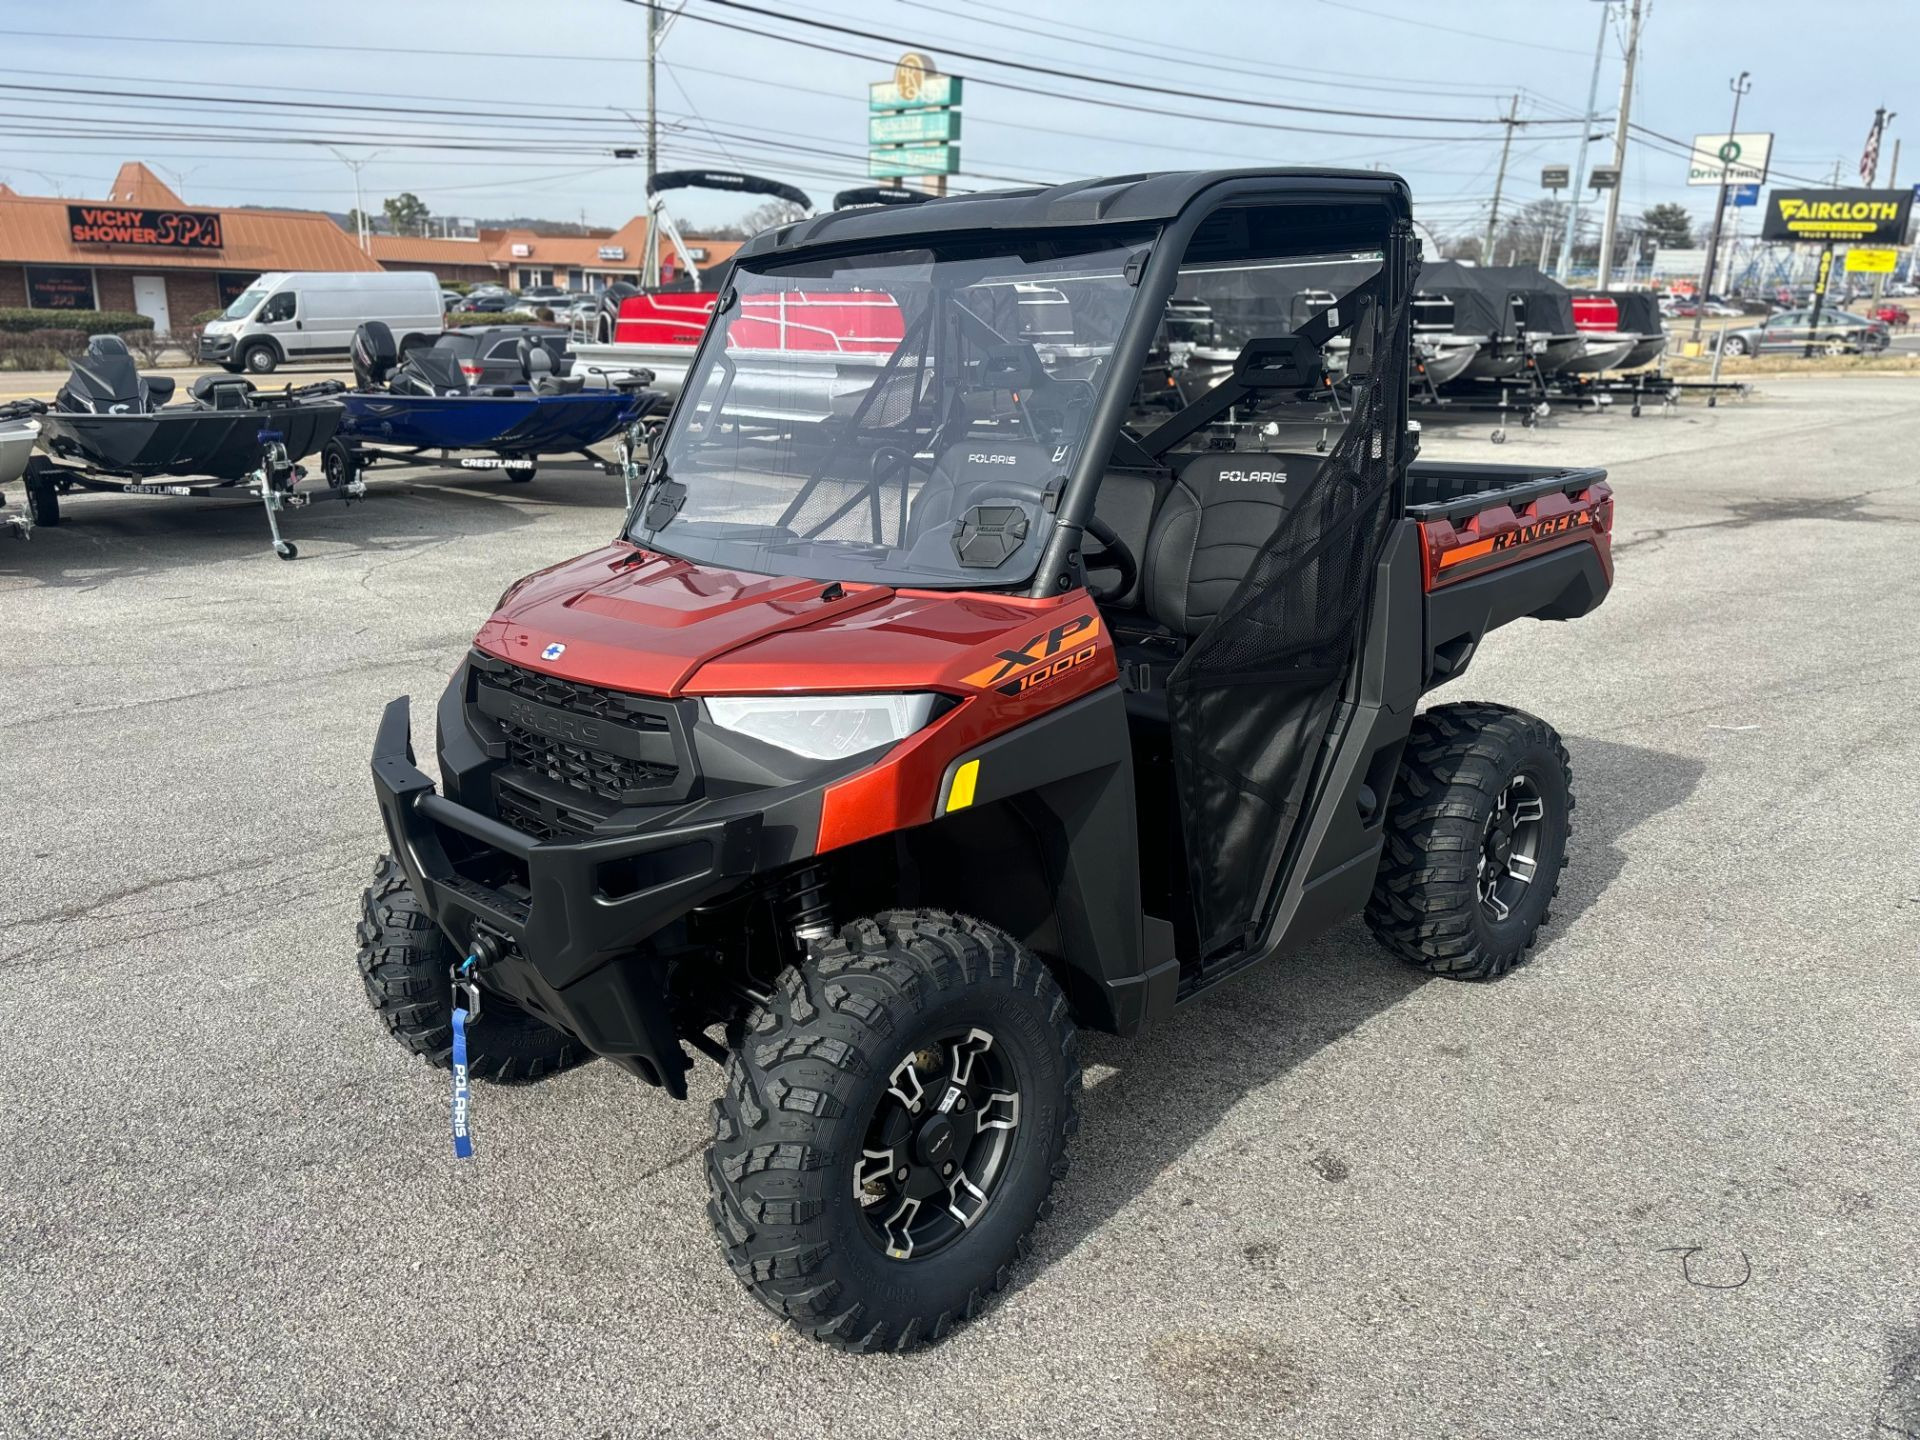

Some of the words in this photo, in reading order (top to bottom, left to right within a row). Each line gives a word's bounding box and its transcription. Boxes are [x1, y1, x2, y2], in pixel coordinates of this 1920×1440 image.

[1691, 168, 1761, 180] DrivTime
[81, 209, 143, 226] VICHY
[1779, 199, 1898, 220] FAIRCLOTH
[72, 225, 157, 243] SHOWER
[156, 213, 221, 246] SPA
[461, 459, 532, 469] CRESTLINER
[968, 454, 1016, 464] POLARIS
[1219, 471, 1287, 483] POLARIS
[123, 485, 190, 495] CRESTLINER
[1491, 510, 1581, 552] RANGER
[987, 614, 1094, 684] XP
[1020, 644, 1097, 691] 1000
[454, 1064, 467, 1137] POLARIS
